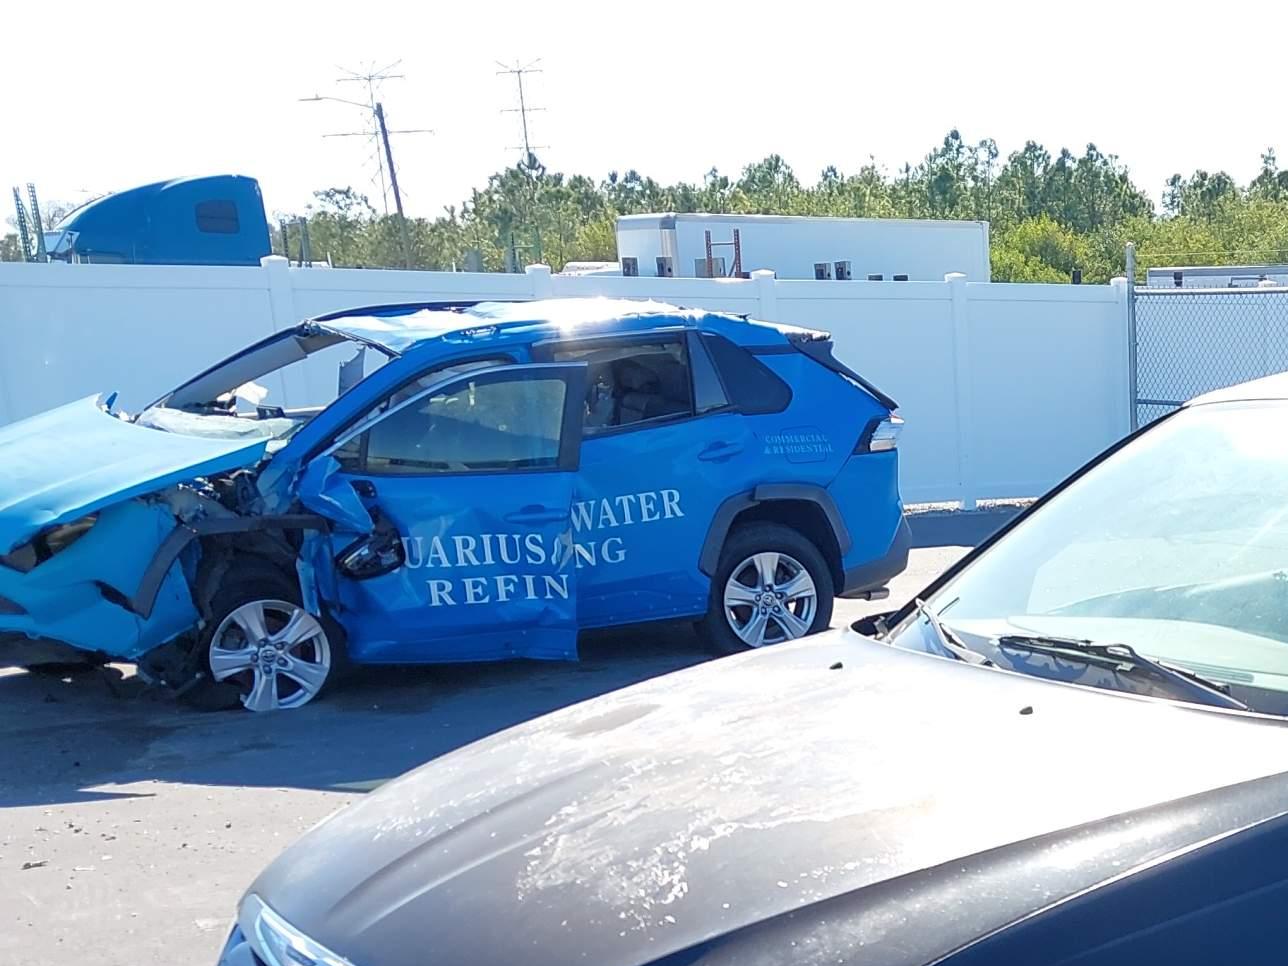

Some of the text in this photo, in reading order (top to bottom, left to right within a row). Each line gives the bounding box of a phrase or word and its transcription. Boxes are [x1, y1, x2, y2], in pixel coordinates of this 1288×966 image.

[571, 489, 685, 533] WATER
[400, 533, 546, 569] UARIUS
[426, 574, 569, 607] REFIN
